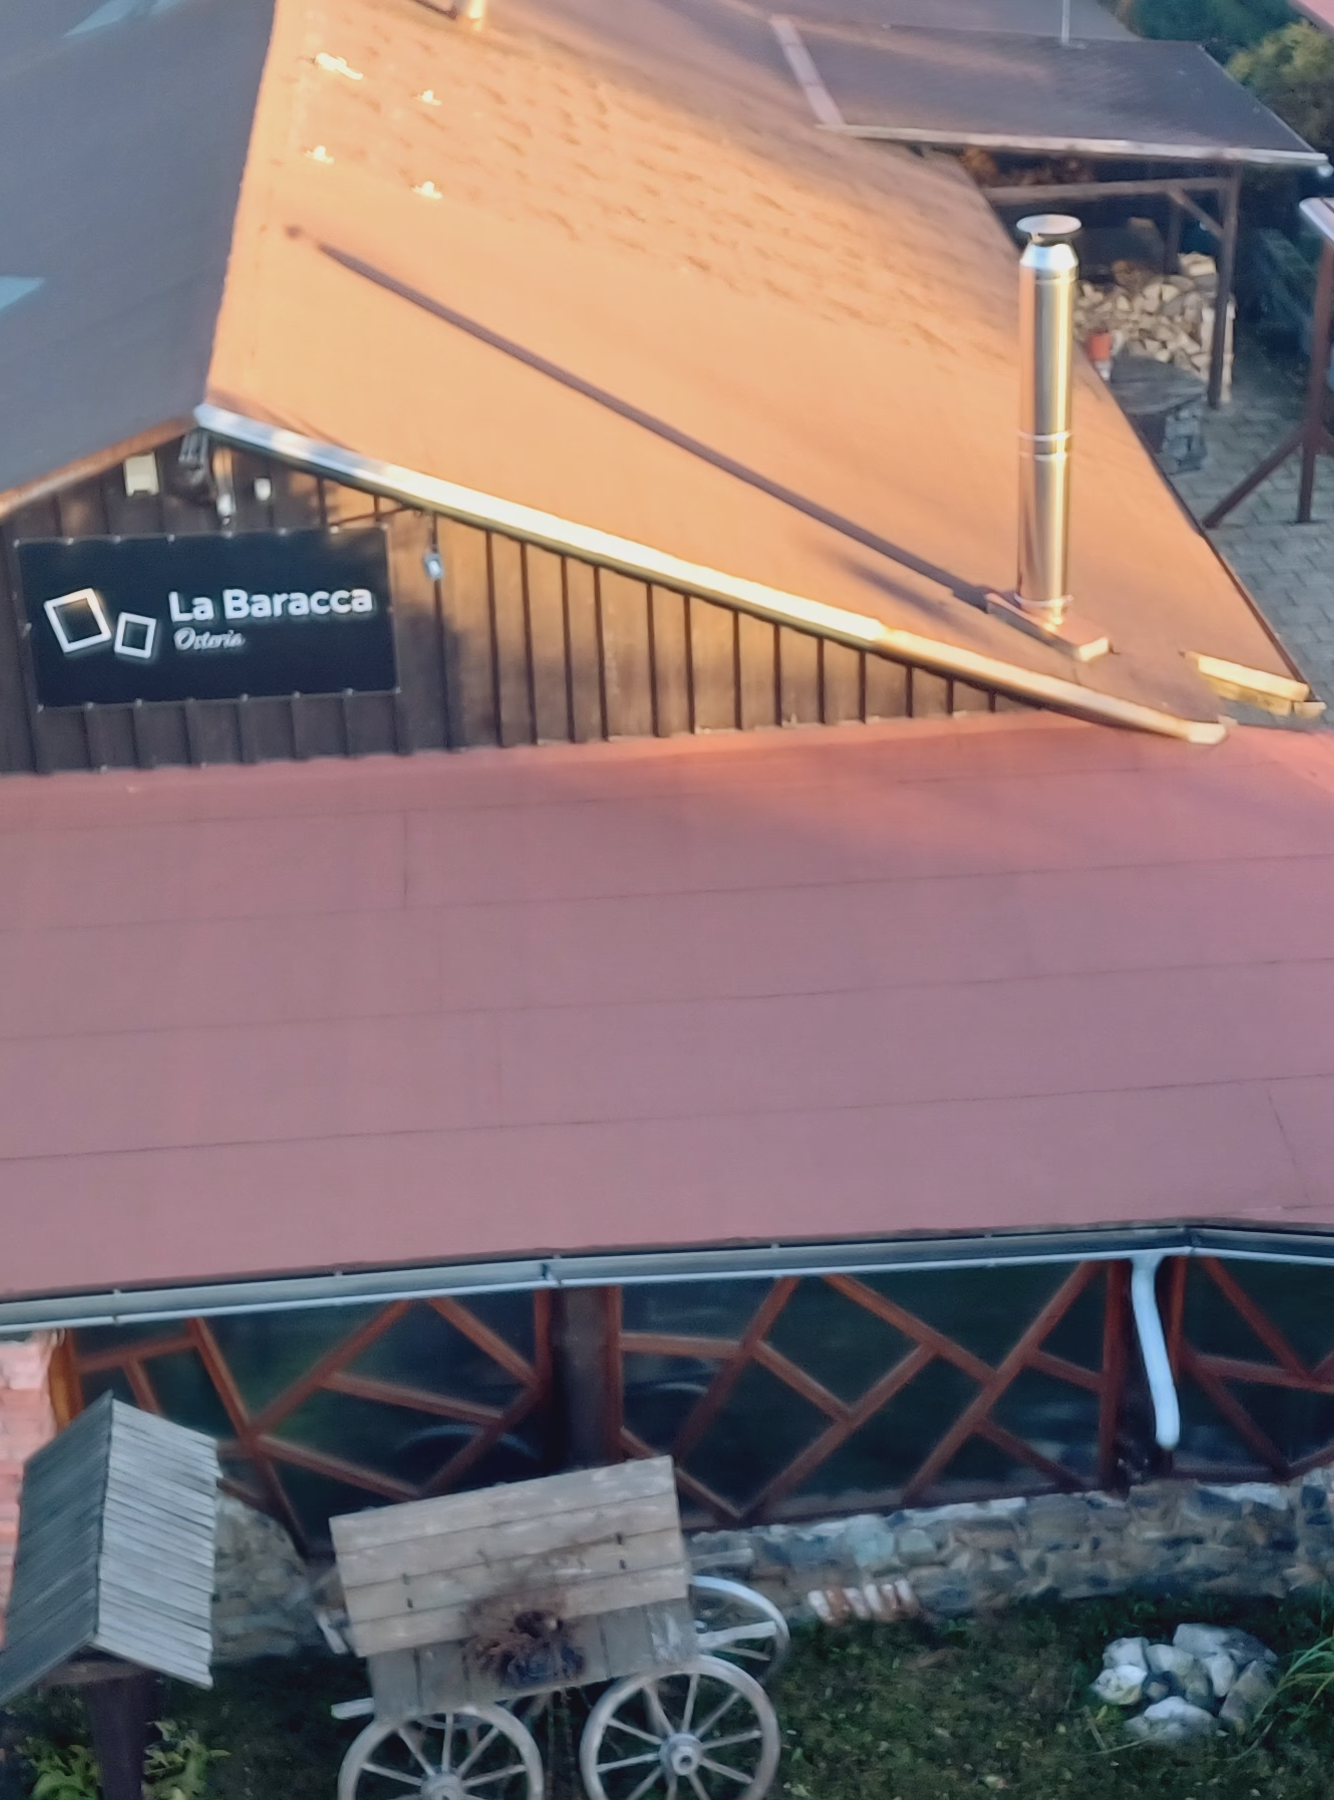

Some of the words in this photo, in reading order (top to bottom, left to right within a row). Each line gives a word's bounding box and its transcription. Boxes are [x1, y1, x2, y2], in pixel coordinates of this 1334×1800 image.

[169, 591, 214, 622] La
[223, 588, 373, 619] Baracca
[173, 627, 246, 650] Osteria
